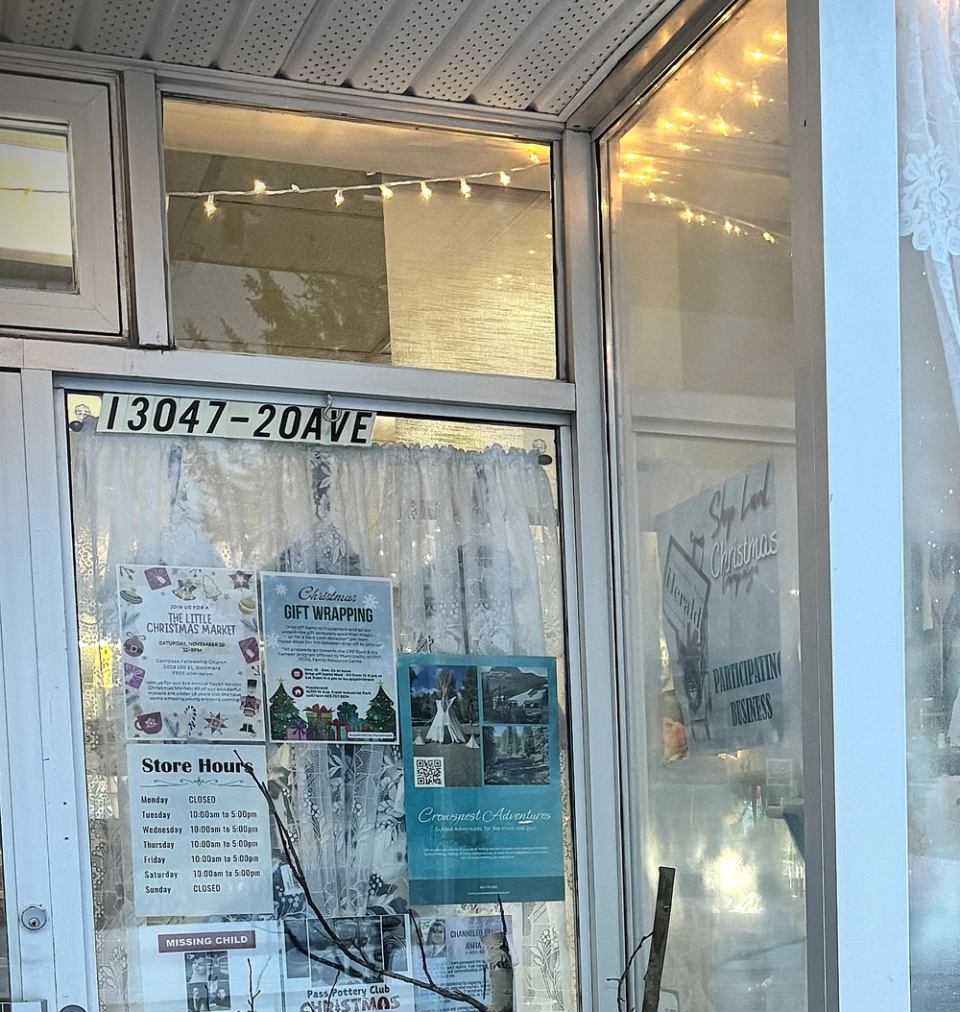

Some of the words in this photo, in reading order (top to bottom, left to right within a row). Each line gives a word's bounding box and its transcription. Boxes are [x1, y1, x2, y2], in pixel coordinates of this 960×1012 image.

[711, 530, 779, 578] Christmas
[298, 585, 358, 603] Christmas
[666, 567, 702, 629] Herald
[168, 612, 183, 624] THE
[185, 613, 213, 625] LITTLE
[284, 604, 310, 620] GIFT
[312, 605, 374, 623] WRAPPING
[146, 622, 200, 635] CHRISTMAS
[202, 624, 236, 636] MARKET
[730, 693, 773, 726] BUSINESS
[141, 757, 193, 774] Store
[198, 757, 254, 774] Hours
[140, 796, 169, 805] Monday
[188, 795, 217, 805] CLOSED
[142, 810, 171, 820] Tuesday
[418, 806, 481, 823] Crowsnest
[482, 807, 551, 823] Adventures
[142, 825, 183, 835] Wednesday
[223, 825, 231, 833] to
[143, 840, 175, 850] Thursday
[223, 840, 231, 848] to
[143, 855, 166, 864] Friday
[224, 855, 231, 863] to
[144, 870, 179, 880] Saturday
[226, 870, 233, 878] to
[145, 885, 172, 895] Sunday
[193, 884, 221, 893] CLOSED
[449, 929, 482, 939] CHANNELED
[166, 936, 213, 947] MISSING
[215, 935, 249, 946] CHILD
[465, 940, 482, 951] ANITA
[307, 989, 329, 999] Pass
[331, 987, 367, 997] Pottery
[369, 984, 390, 995] Club
